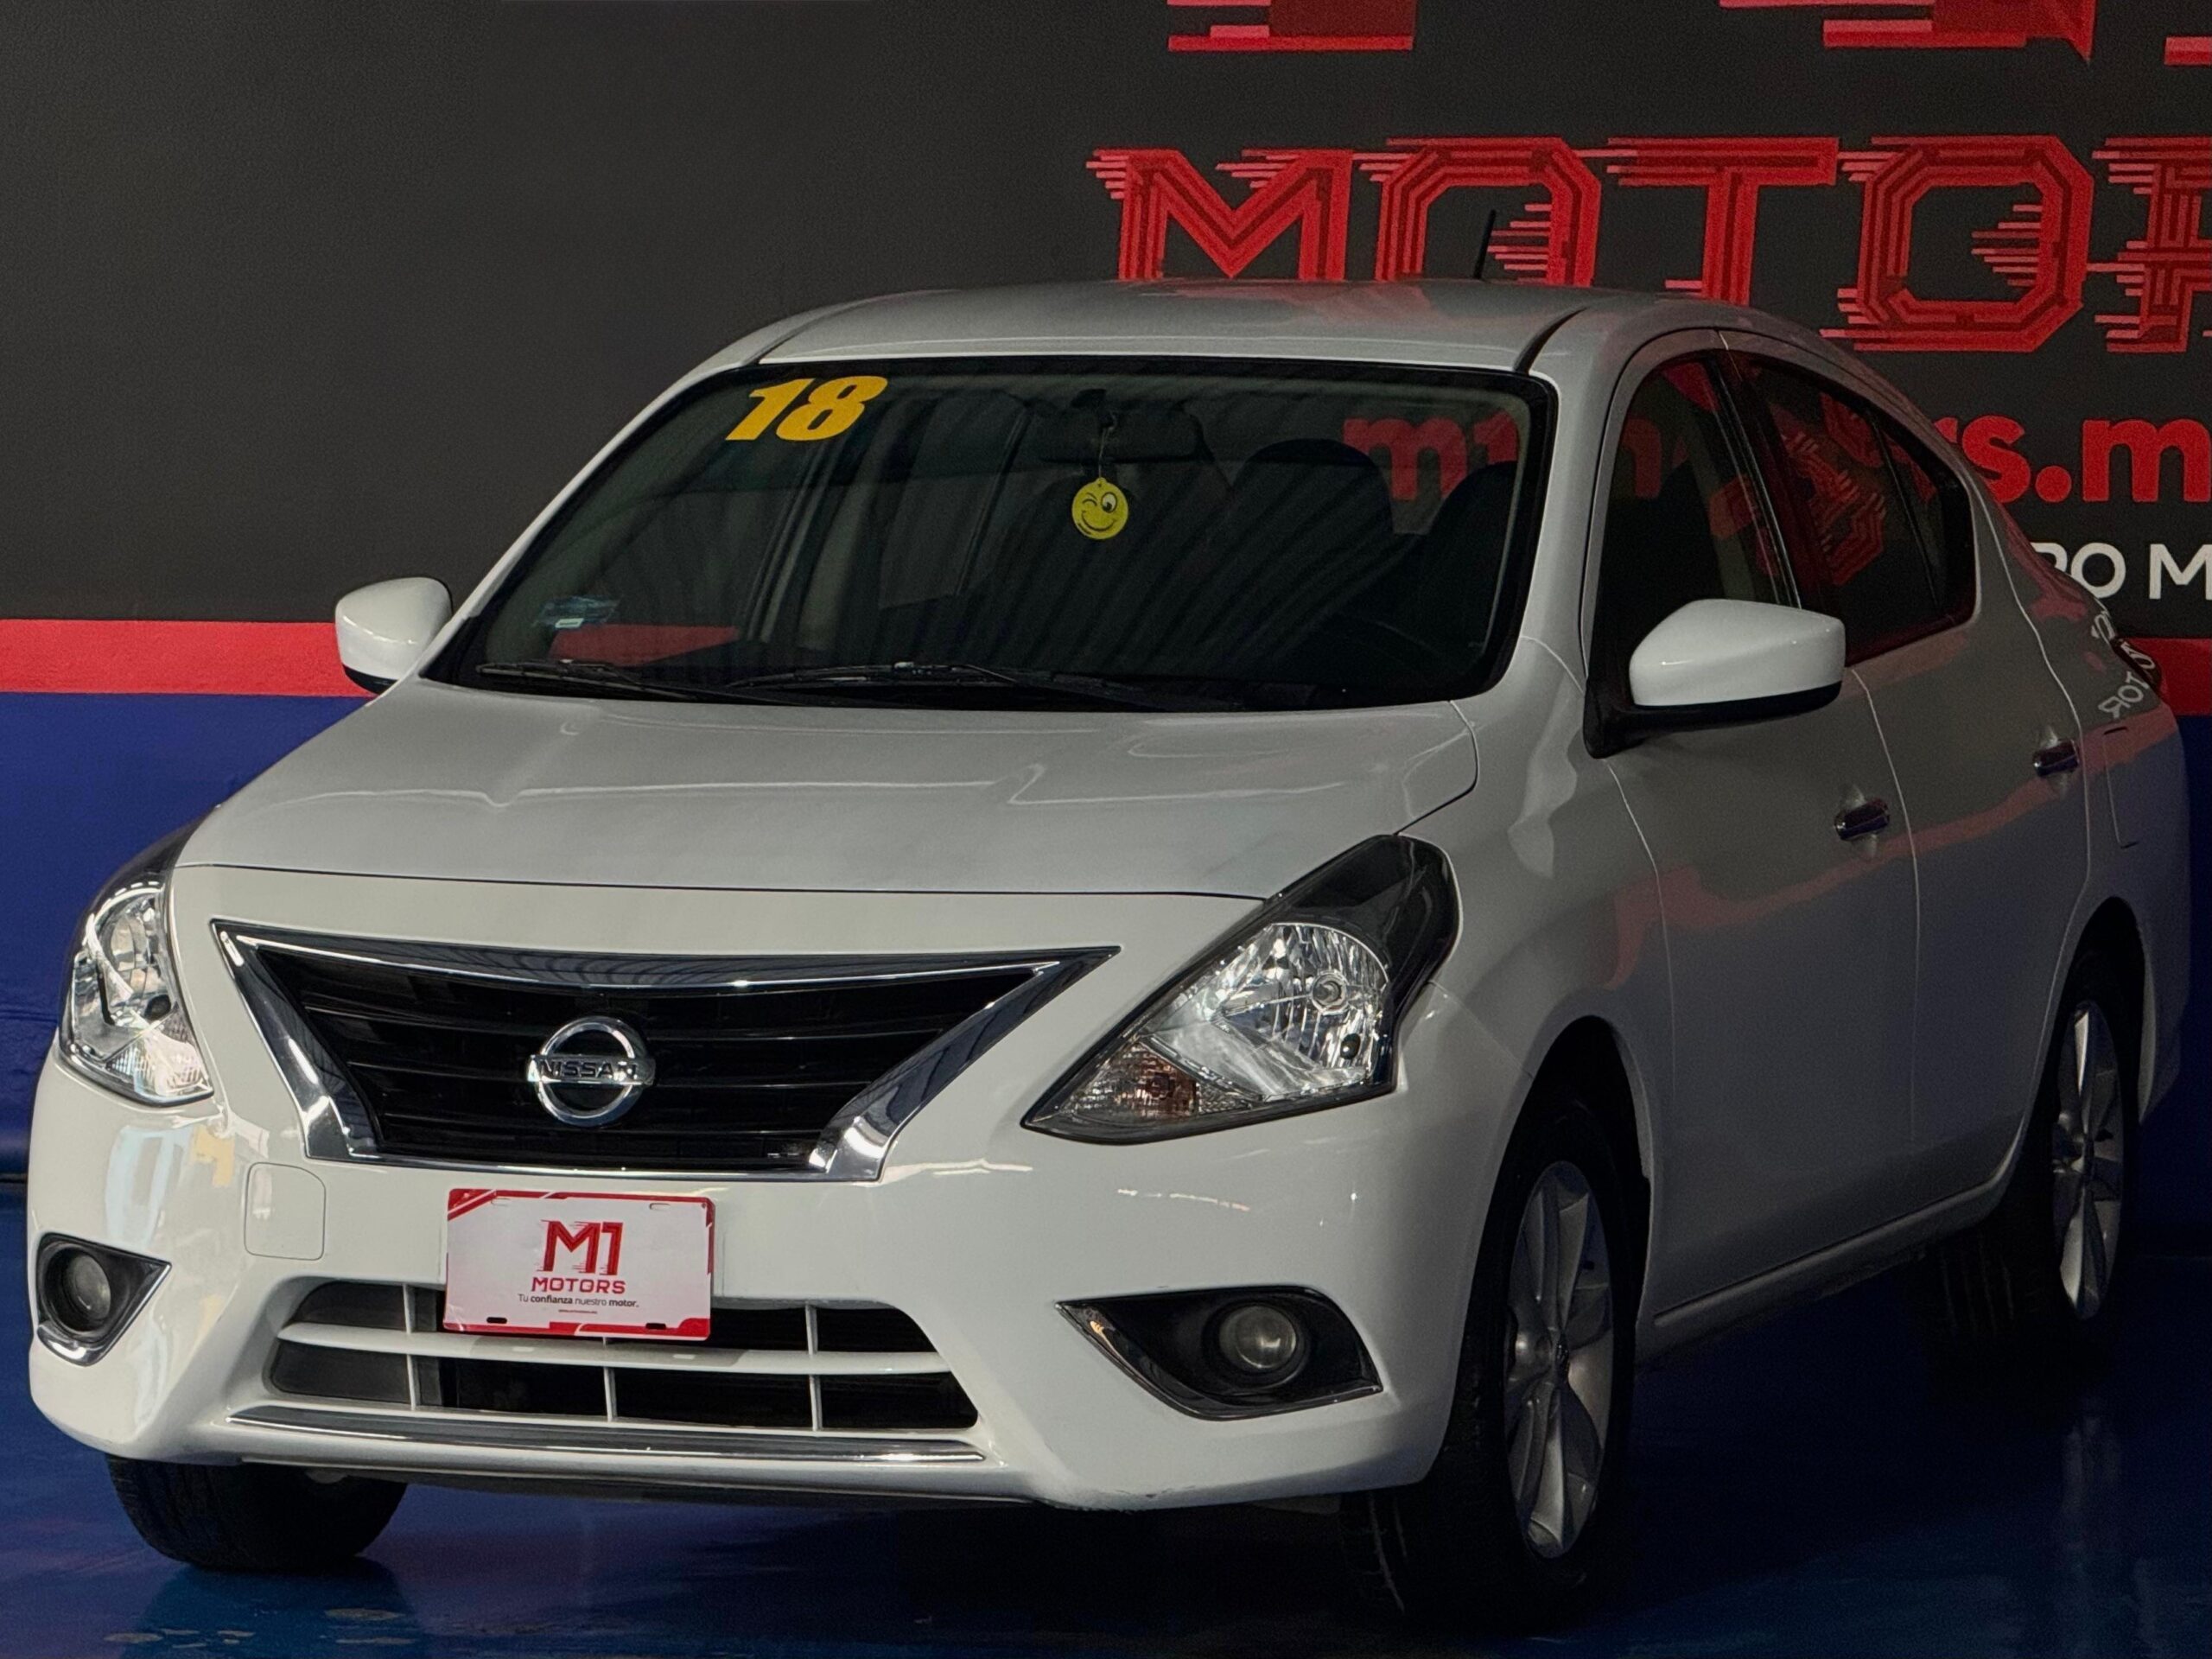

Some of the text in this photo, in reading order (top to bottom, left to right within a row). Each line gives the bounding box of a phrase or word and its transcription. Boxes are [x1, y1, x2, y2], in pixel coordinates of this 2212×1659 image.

[725, 375, 888, 442] 18
[537, 1219, 624, 1276] M1
[518, 1294, 639, 1308] Tu confianza nuestro motor.
[531, 1276, 626, 1294] MOTORS
